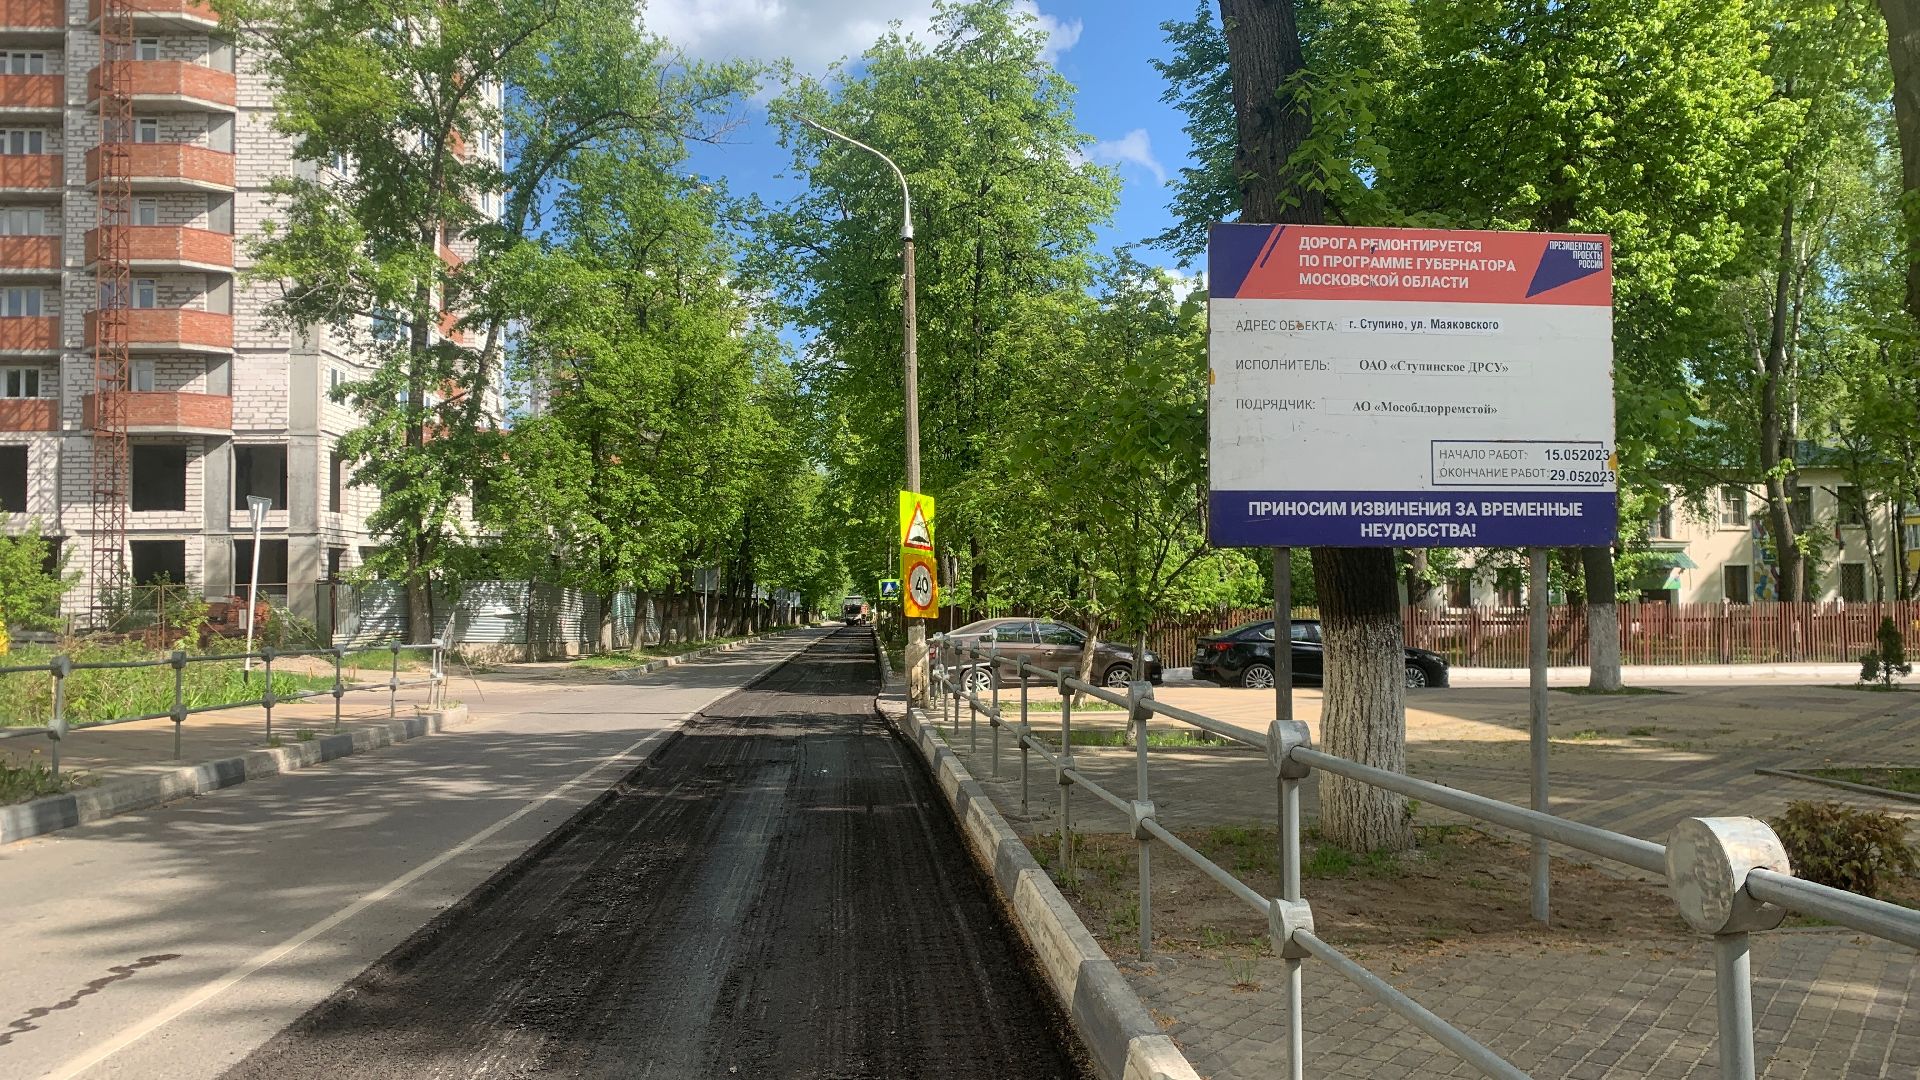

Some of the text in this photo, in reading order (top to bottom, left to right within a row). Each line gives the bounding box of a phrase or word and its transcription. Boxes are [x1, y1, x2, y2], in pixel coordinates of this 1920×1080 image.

[1299, 236, 1481, 253] ДОРОГА РЕМОНТИРУЕТСЯ
[1549, 241, 1603, 250] ПРЕЗИДЕНТСКИЕ
[1299, 254, 1516, 272] ПО ПРОГРАММЕ ГУБЕРНАТОРА
[1572, 251, 1603, 260] ПРОЕКТЫ
[1578, 260, 1603, 269] РОССИИ
[1299, 272, 1469, 288] МОСКОВСКОЙ ОБЛАСТИ
[1235, 320, 1276, 332] АДРЕС
[1360, 318, 1407, 331] Ступино,
[1410, 320, 1427, 332] ул.
[1430, 318, 1499, 330] Маяковского
[1235, 359, 1509, 374] ИСПОЛНИТЕЛЬ: ОАО «Ступинское ДРСУ»
[1236, 398, 1316, 411] ПОДРЯДЧИК:
[1352, 401, 1371, 412] АО
[1439, 449, 1610, 461] НАЧАЛО РАБОТ: 15.052023
[1439, 468, 1615, 483] ОКОНЧАНИЕ РАБОТ: 29.052023
[1248, 501, 1583, 517] ПРИНОСИМ ИЗВИНЕНИЯ ЗА ВРЕМЕННЫЕ
[1360, 522, 1477, 540] НЕУДОБСТВА!
[915, 576, 929, 594] 40
